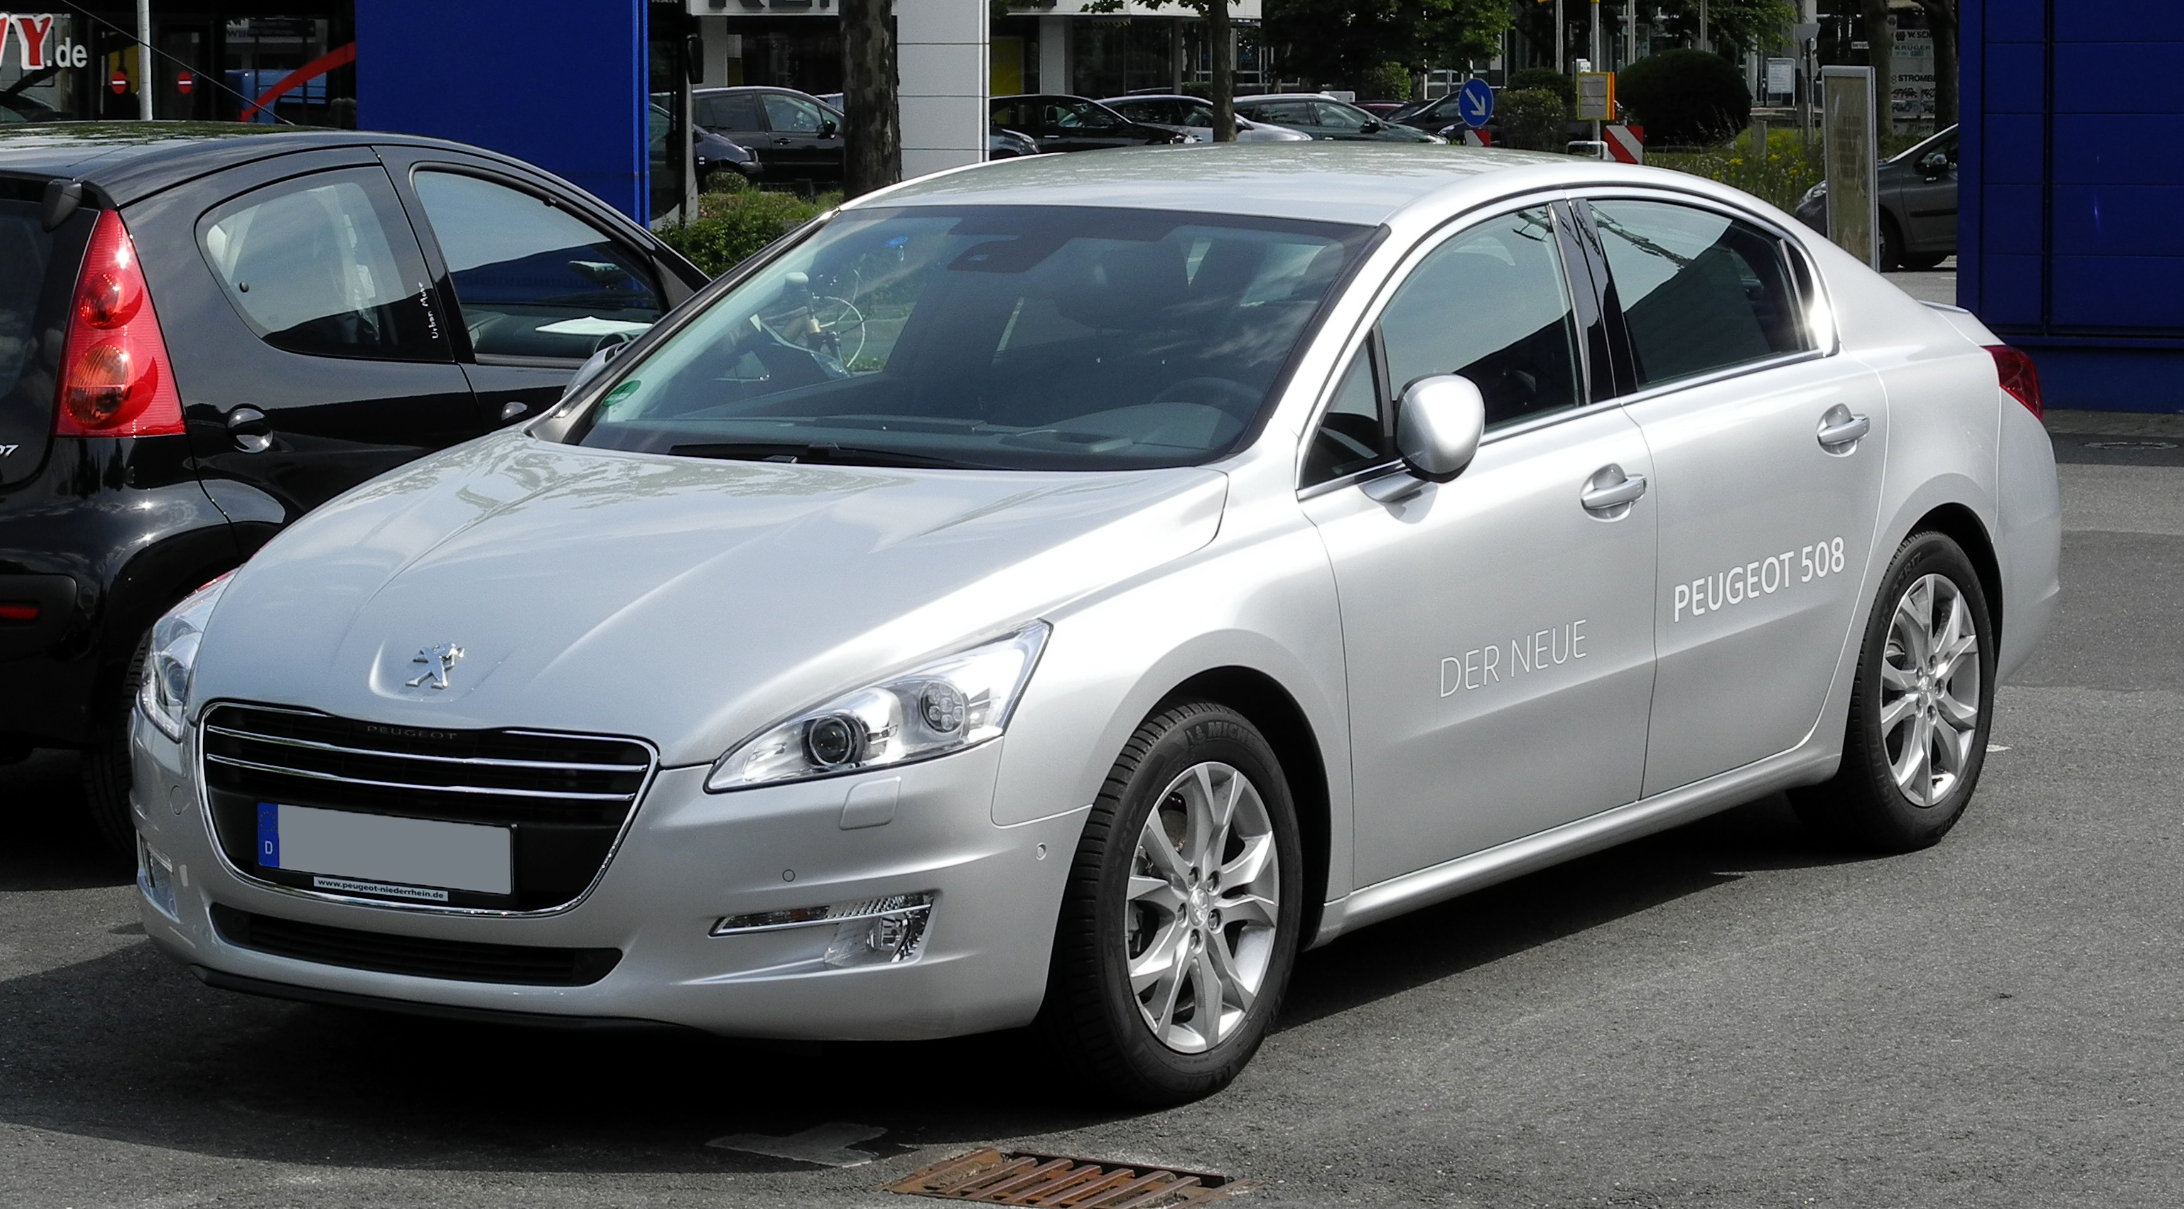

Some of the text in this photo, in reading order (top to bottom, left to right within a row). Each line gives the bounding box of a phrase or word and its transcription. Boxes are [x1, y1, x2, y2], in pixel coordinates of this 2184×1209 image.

[1898, 74, 1935, 82] STROMB
[1674, 536, 1846, 623] PEUGEOT 508
[1440, 618, 1588, 698] DER NEUE
[367, 725, 457, 740] PEUGEOT
[264, 840, 273, 855] D
[317, 879, 444, 899] www.peugeot-niederrhein.de
